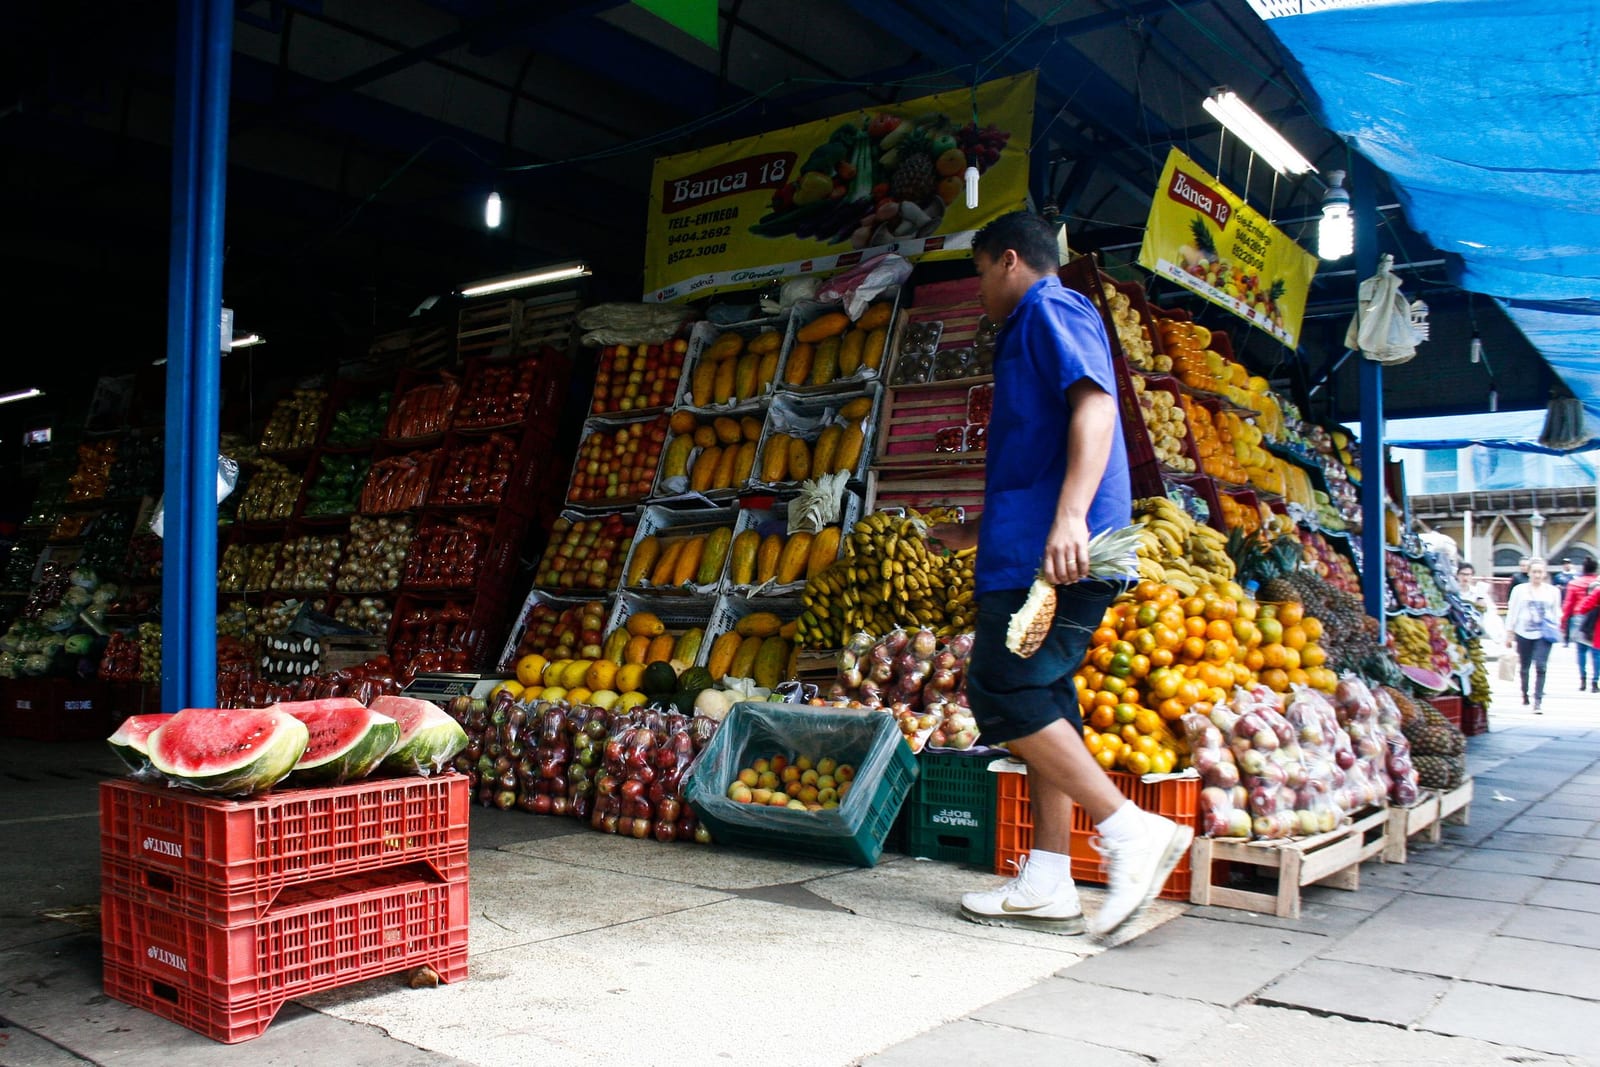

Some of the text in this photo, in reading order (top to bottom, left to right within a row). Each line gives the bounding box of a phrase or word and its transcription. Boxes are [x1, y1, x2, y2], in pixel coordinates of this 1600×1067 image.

[672, 159, 786, 204] Banca 18
[1173, 173, 1229, 223] Banca 18
[668, 206, 739, 229] TELE-ENTREGA
[668, 226, 731, 246] 9404.2692
[667, 243, 727, 265] 8522.3008
[940, 809, 972, 819] BOFF
